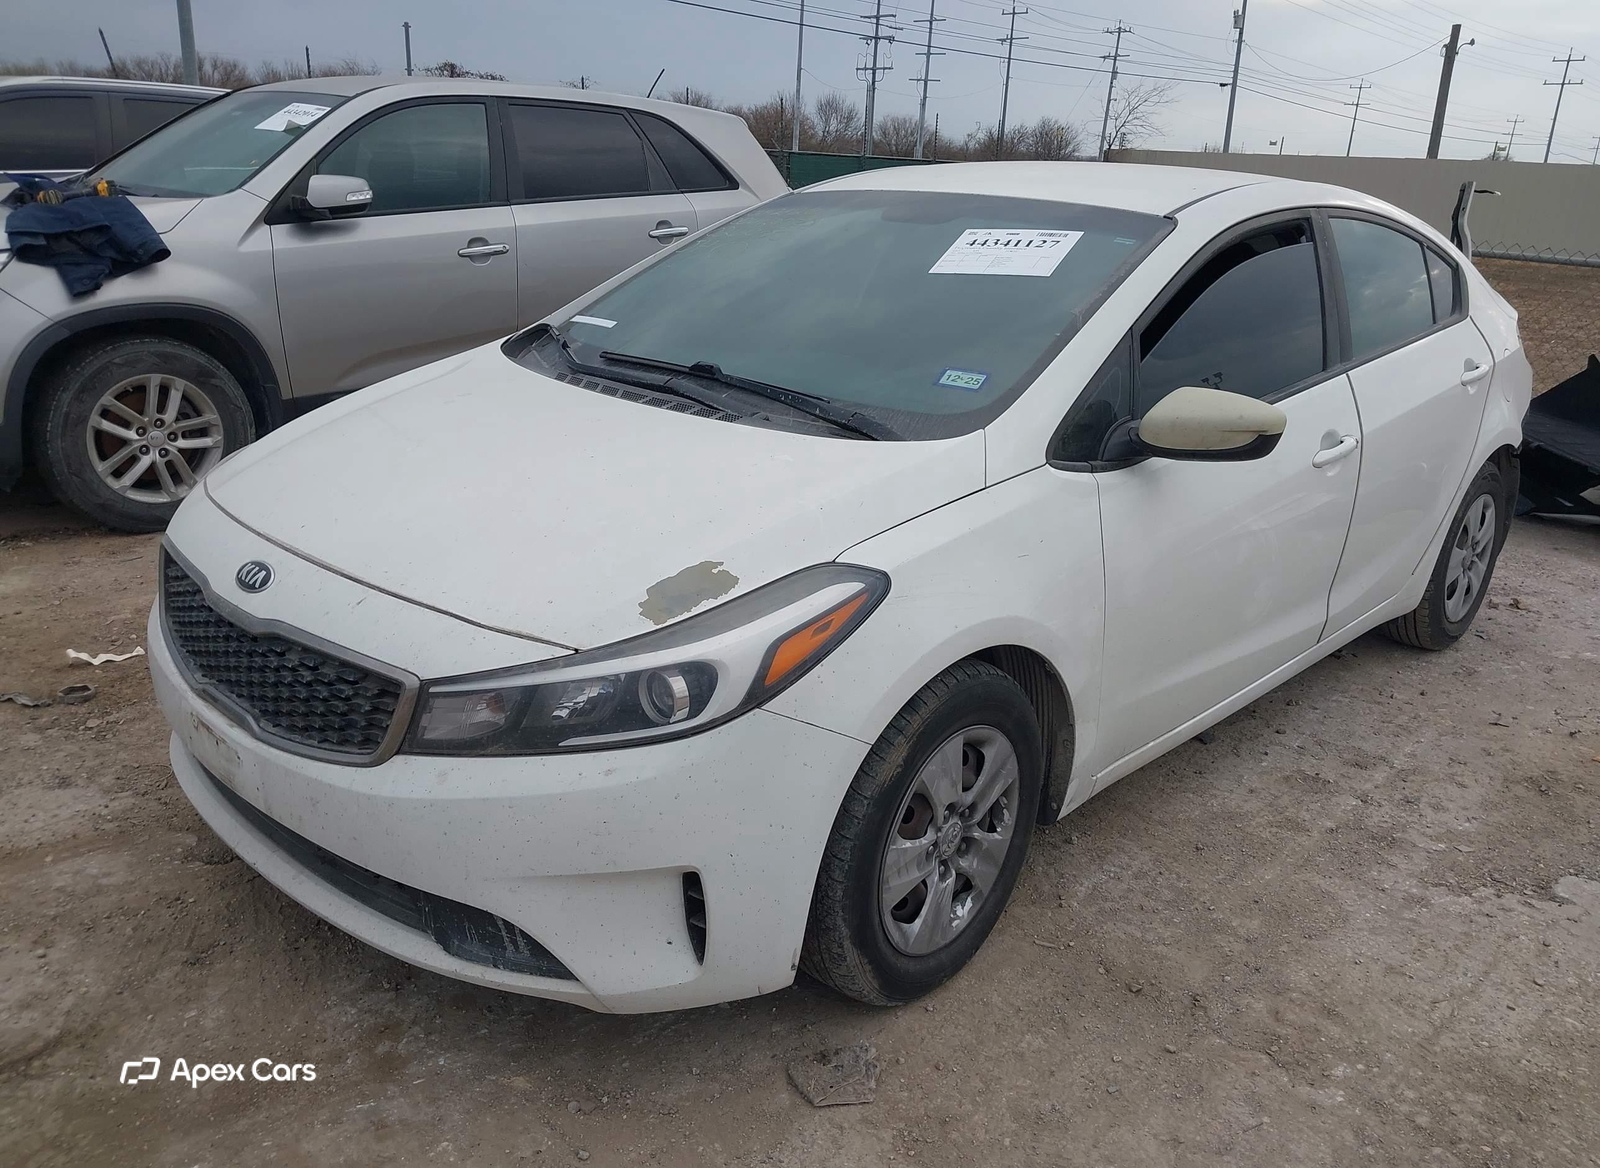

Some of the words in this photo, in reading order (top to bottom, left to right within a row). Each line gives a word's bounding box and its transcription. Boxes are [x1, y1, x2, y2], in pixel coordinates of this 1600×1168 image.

[965, 238, 1061, 249] 44341127
[945, 374, 961, 383] 12
[964, 376, 982, 386] 25
[238, 562, 267, 589] KIA
